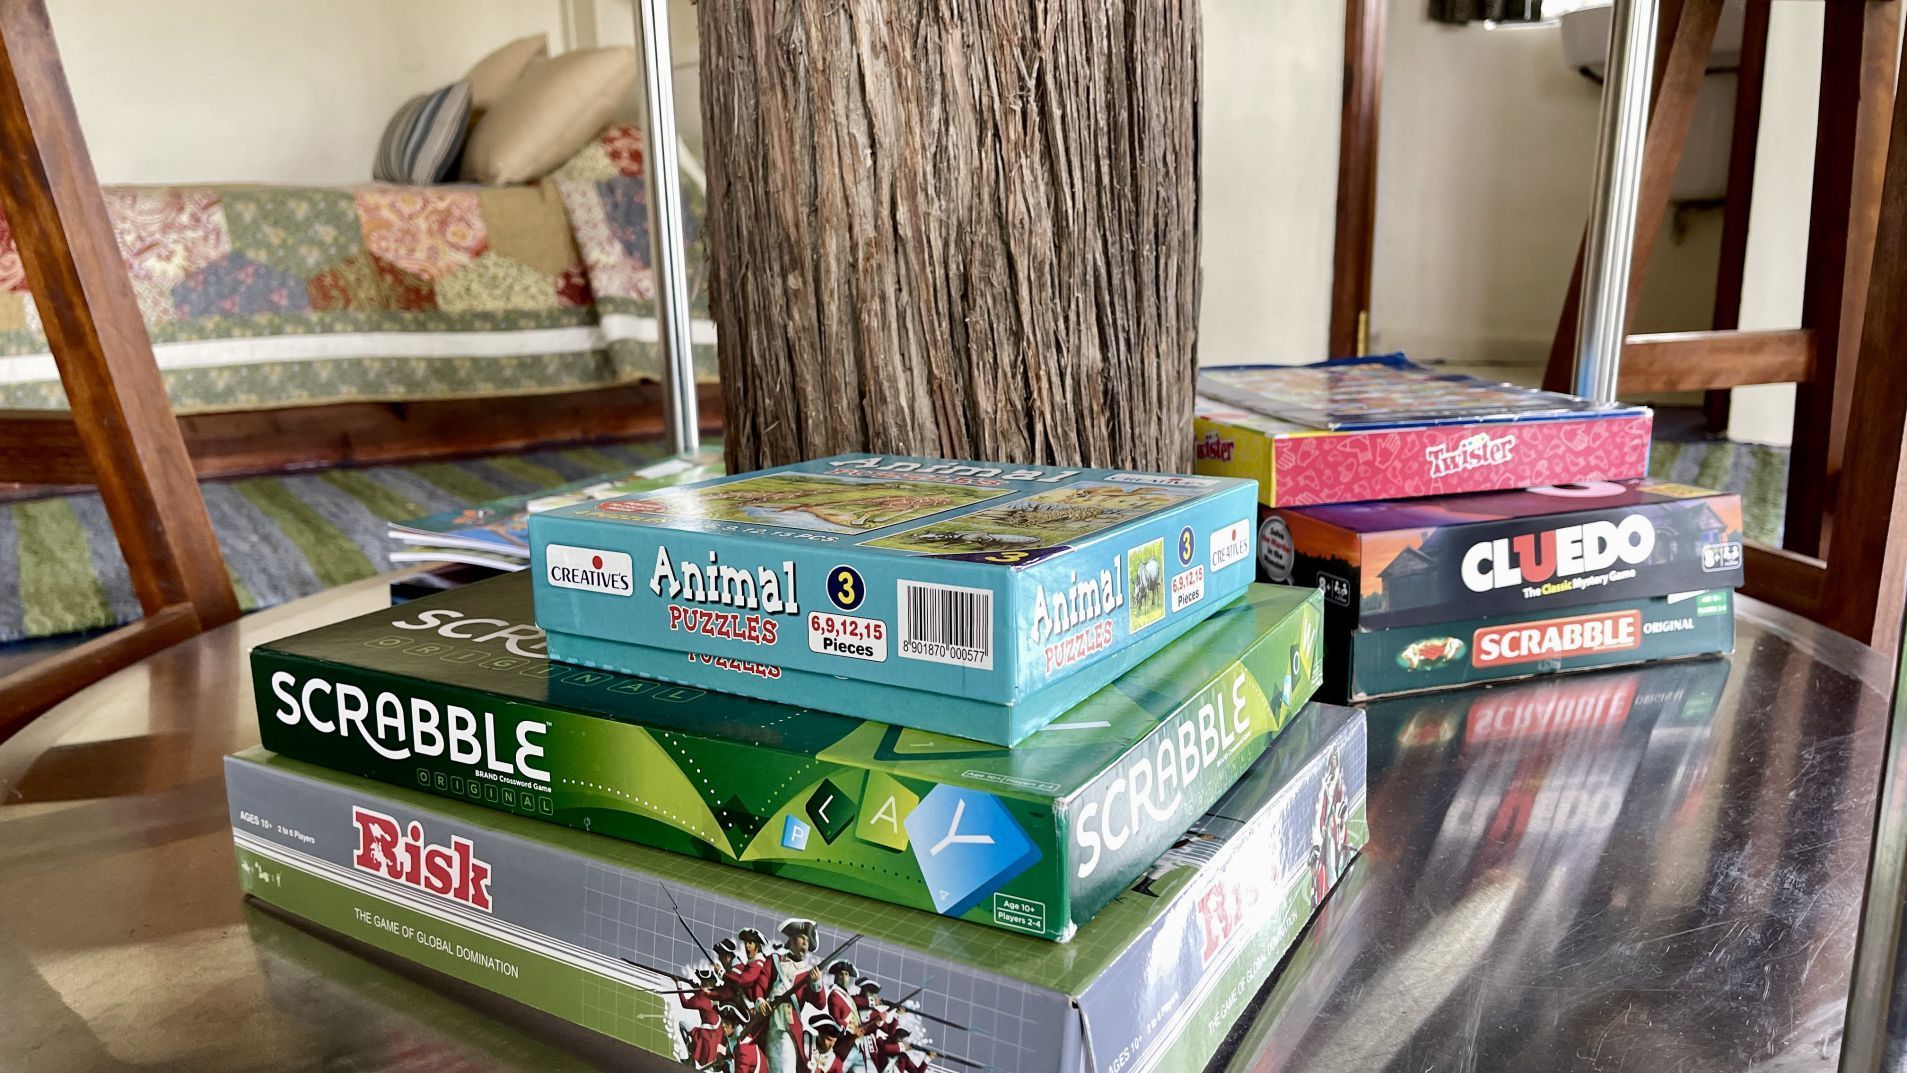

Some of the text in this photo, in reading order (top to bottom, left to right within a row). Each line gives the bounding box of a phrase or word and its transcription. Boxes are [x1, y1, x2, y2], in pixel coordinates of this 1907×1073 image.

[827, 457, 1082, 482] Animal
[1428, 434, 1514, 478] Twister
[984, 551, 1029, 563] 3
[1182, 531, 1192, 560] 3
[1461, 514, 1655, 592] CLUEDO
[551, 565, 629, 590] CREATIVE'S
[650, 545, 799, 615] Animal
[837, 571, 855, 605] 3
[1522, 569, 1636, 599] The Classic Mystery Game
[1030, 554, 1125, 646] Animal
[1177, 590, 1200, 608] Pieces
[667, 605, 778, 646] PUZZLES
[811, 615, 883, 641] 6,9,12,15
[1479, 615, 1636, 661] SCRABBLE
[1643, 618, 1696, 635] ORIGINAL
[823, 637, 874, 658] Pieces
[903, 640, 985, 663] 8 901870 000577
[1044, 620, 1113, 675] PUZZLES
[271, 671, 552, 782] SCRABBLE
[475, 769, 552, 793] BRAND Crossword Game
[1077, 672, 1250, 879] SCRABBLE
[240, 810, 260, 825] AGES
[261, 819, 272, 829] 10+
[294, 830, 316, 844] Players
[354, 806, 492, 913] Risk
[998, 911, 1042, 929] Players 2-4
[1003, 899, 1035, 912] Age 10+
[354, 907, 519, 978] THE GAME OF GLOBAL DOMINATION
[1207, 1014, 1221, 1037] THE
